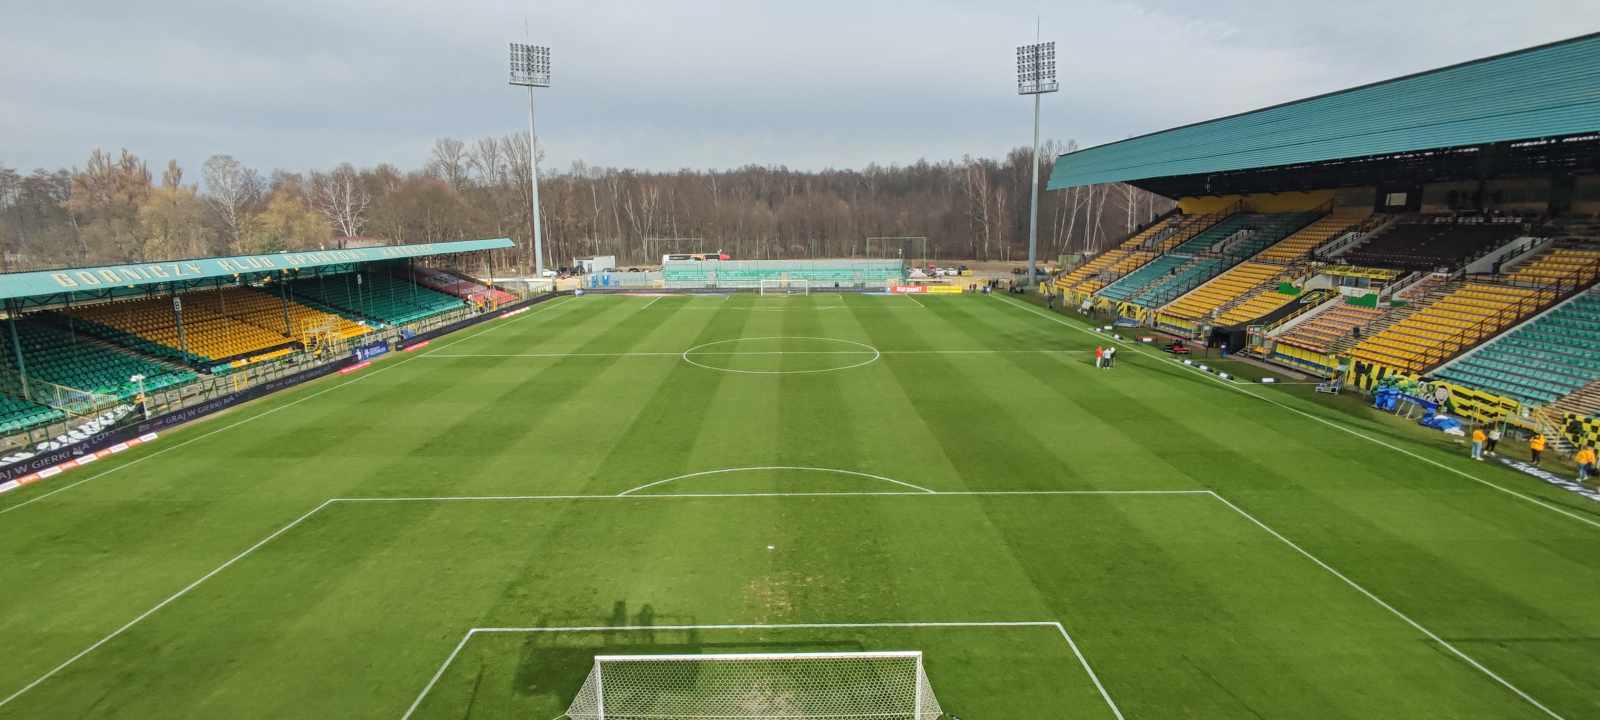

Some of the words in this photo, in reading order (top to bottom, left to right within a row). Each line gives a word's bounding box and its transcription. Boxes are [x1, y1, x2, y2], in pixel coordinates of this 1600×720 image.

[166, 411, 186, 424] GRAJ
[187, 408, 196, 417] W
[15, 464, 28, 474] W
